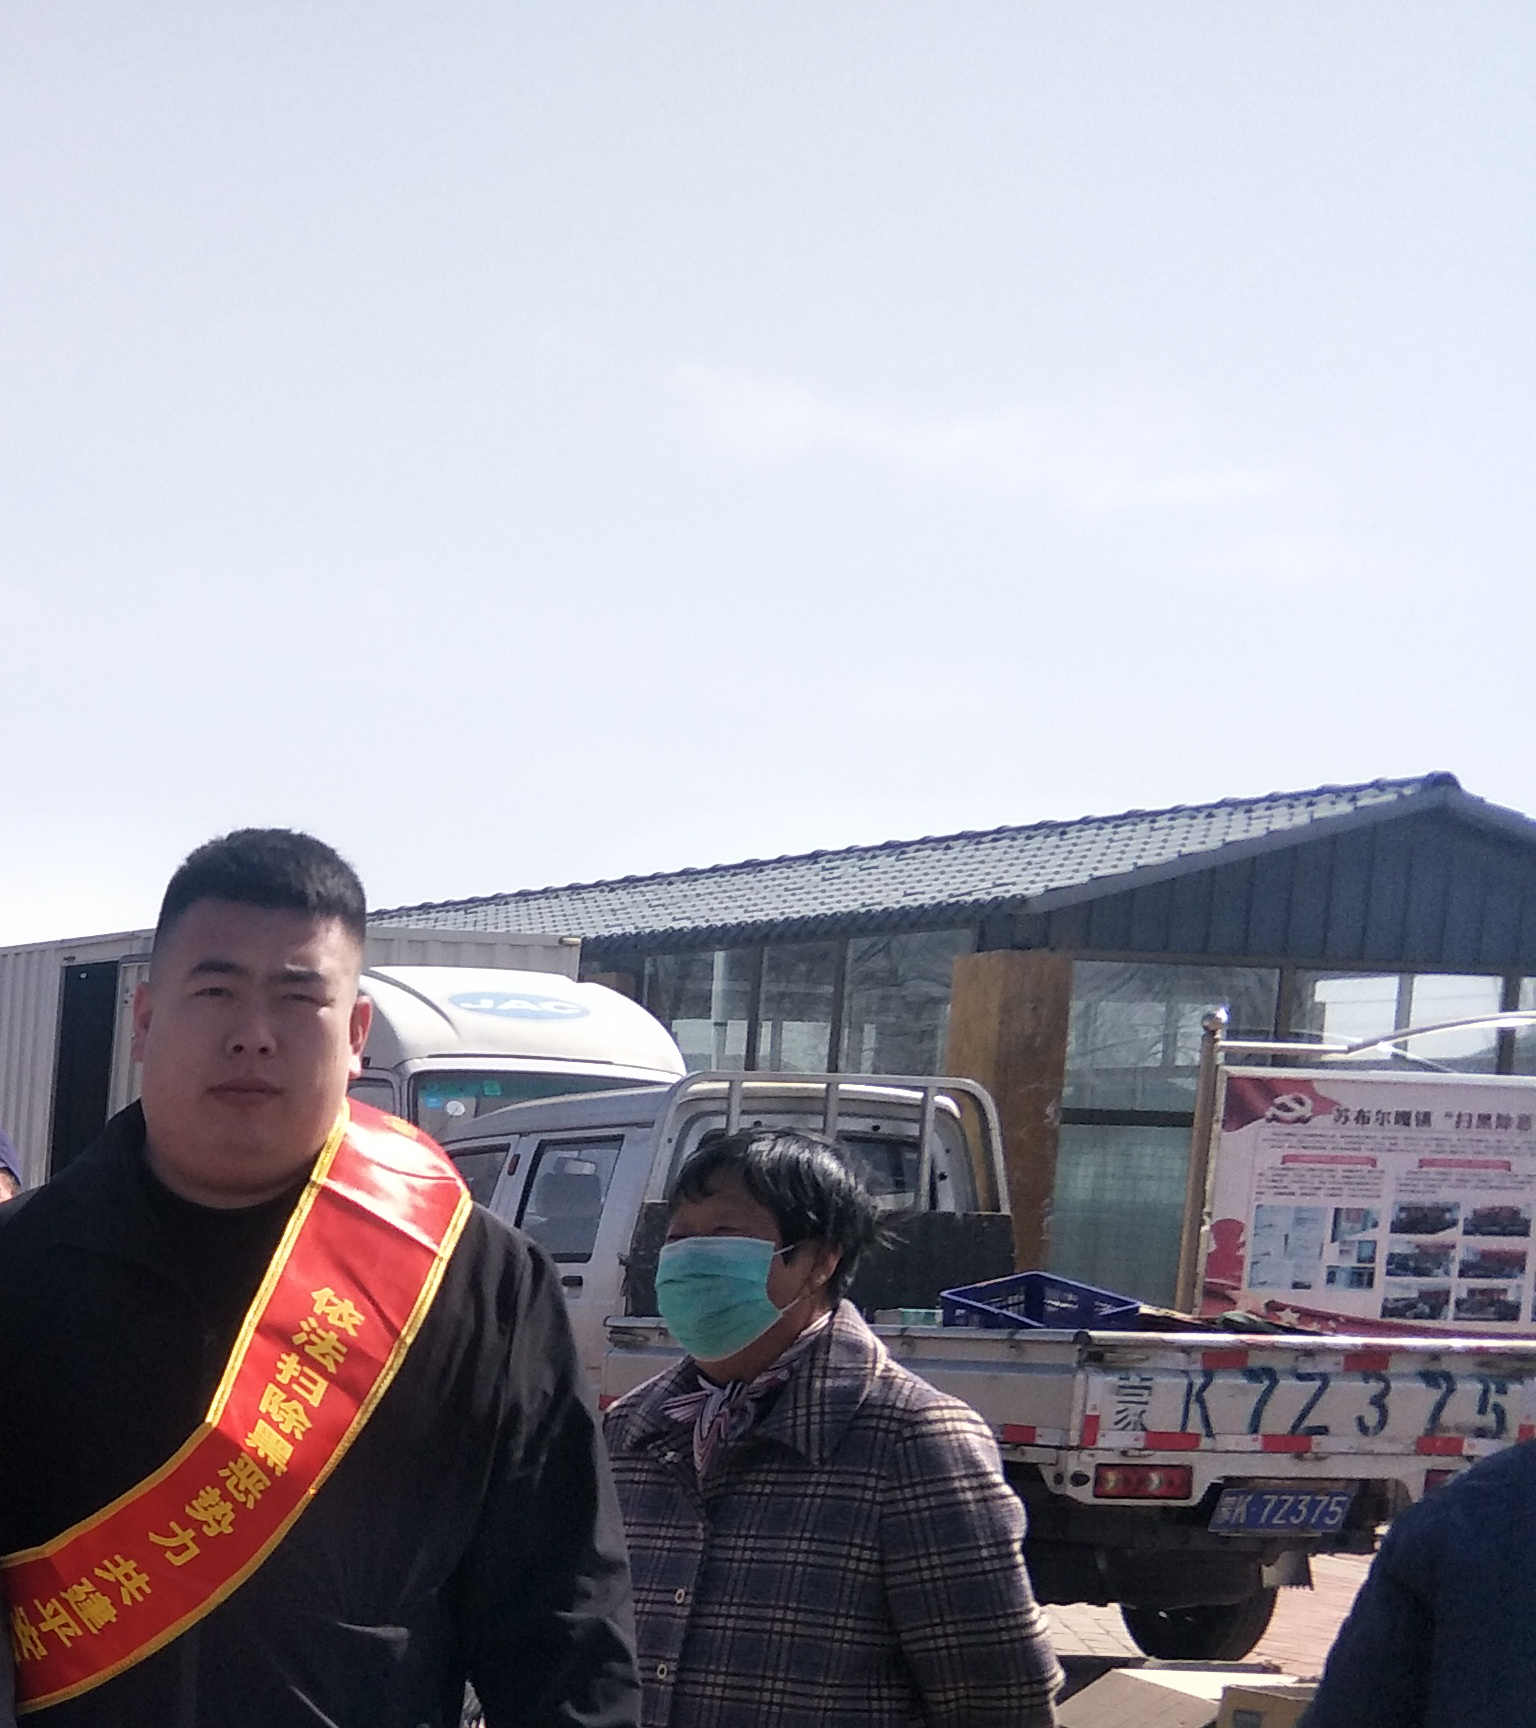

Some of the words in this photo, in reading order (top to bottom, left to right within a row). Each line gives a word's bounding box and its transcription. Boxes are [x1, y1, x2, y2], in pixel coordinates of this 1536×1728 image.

[459, 998, 581, 1014] JAC
[148, 1287, 366, 1567] 依法扫除黑恶势力
